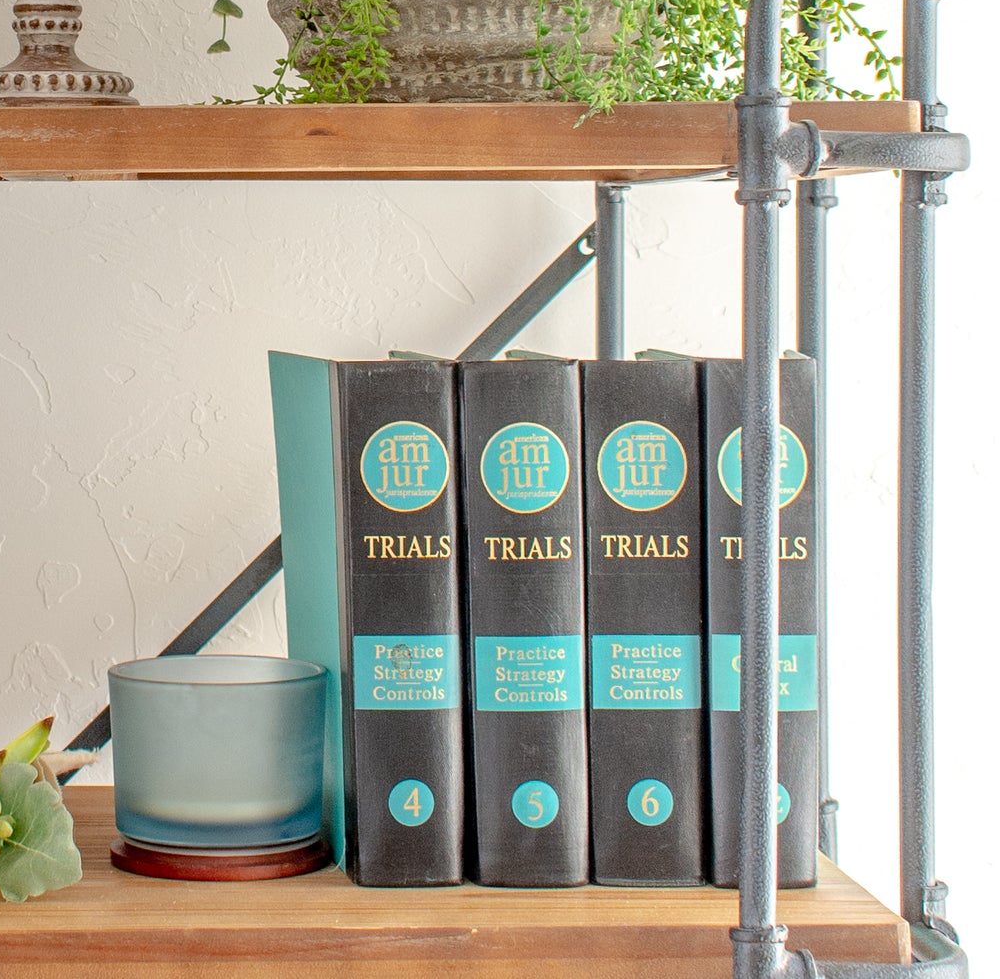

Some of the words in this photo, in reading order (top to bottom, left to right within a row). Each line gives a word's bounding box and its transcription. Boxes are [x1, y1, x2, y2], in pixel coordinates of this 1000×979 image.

[379, 438, 430, 463] am
[499, 440, 551, 465] am
[616, 438, 667, 462] am
[376, 465, 429, 493] jur
[497, 466, 549, 495] jur
[613, 464, 666, 492] jur
[363, 535, 451, 559] TRIALS
[484, 536, 572, 560] TRIALS
[601, 535, 689, 558] TRIALS
[720, 536, 808, 560] TLS
[374, 644, 444, 659] Practice
[496, 646, 566, 660] Practice
[611, 643, 682, 658] Practice
[374, 665, 444, 682] Strategy
[495, 667, 566, 682] Strategy
[611, 665, 682, 681] Strategy
[372, 686, 446, 700] Controls
[494, 688, 568, 702] Controls
[609, 685, 683, 700] Controls
[403, 787, 421, 817] 4
[527, 791, 543, 821] 5
[641, 786, 660, 817] 6
